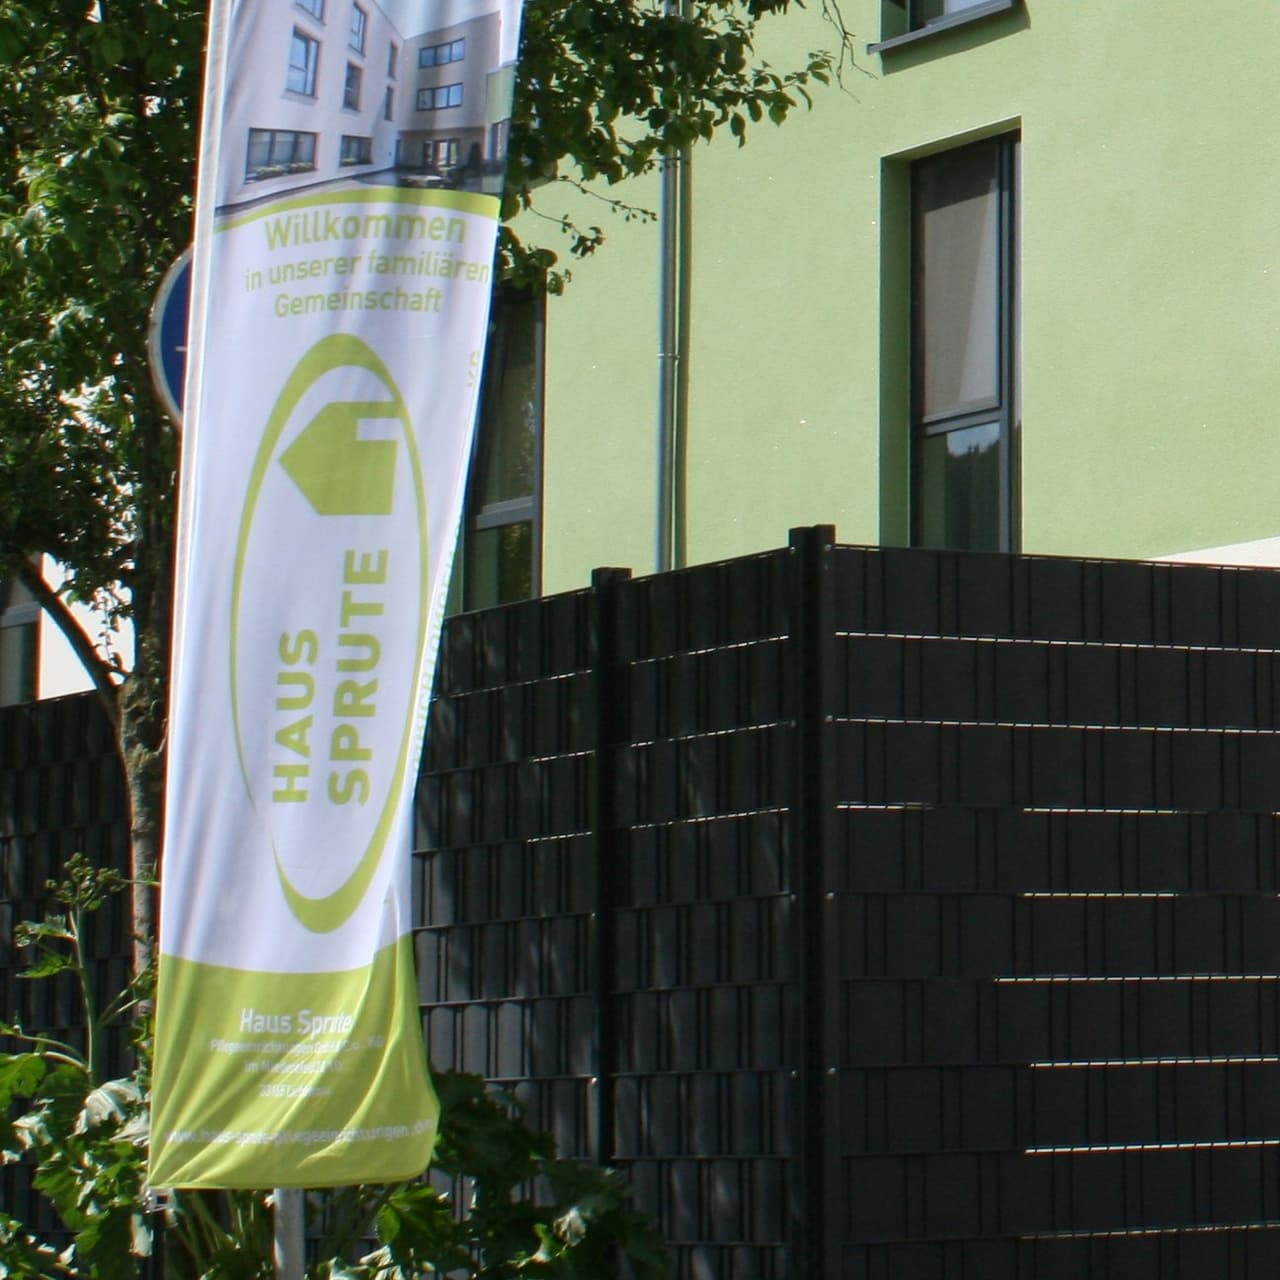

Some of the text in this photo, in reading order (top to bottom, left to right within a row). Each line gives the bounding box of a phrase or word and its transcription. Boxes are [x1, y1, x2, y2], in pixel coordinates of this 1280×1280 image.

[264, 210, 467, 250] Willkommen
[245, 249, 489, 292] in unserer familiären
[274, 286, 443, 318] Gemeinschaft
[327, 549, 389, 806] SPRUTE
[272, 629, 320, 803] HAUS
[240, 1007, 292, 1033] Haus
